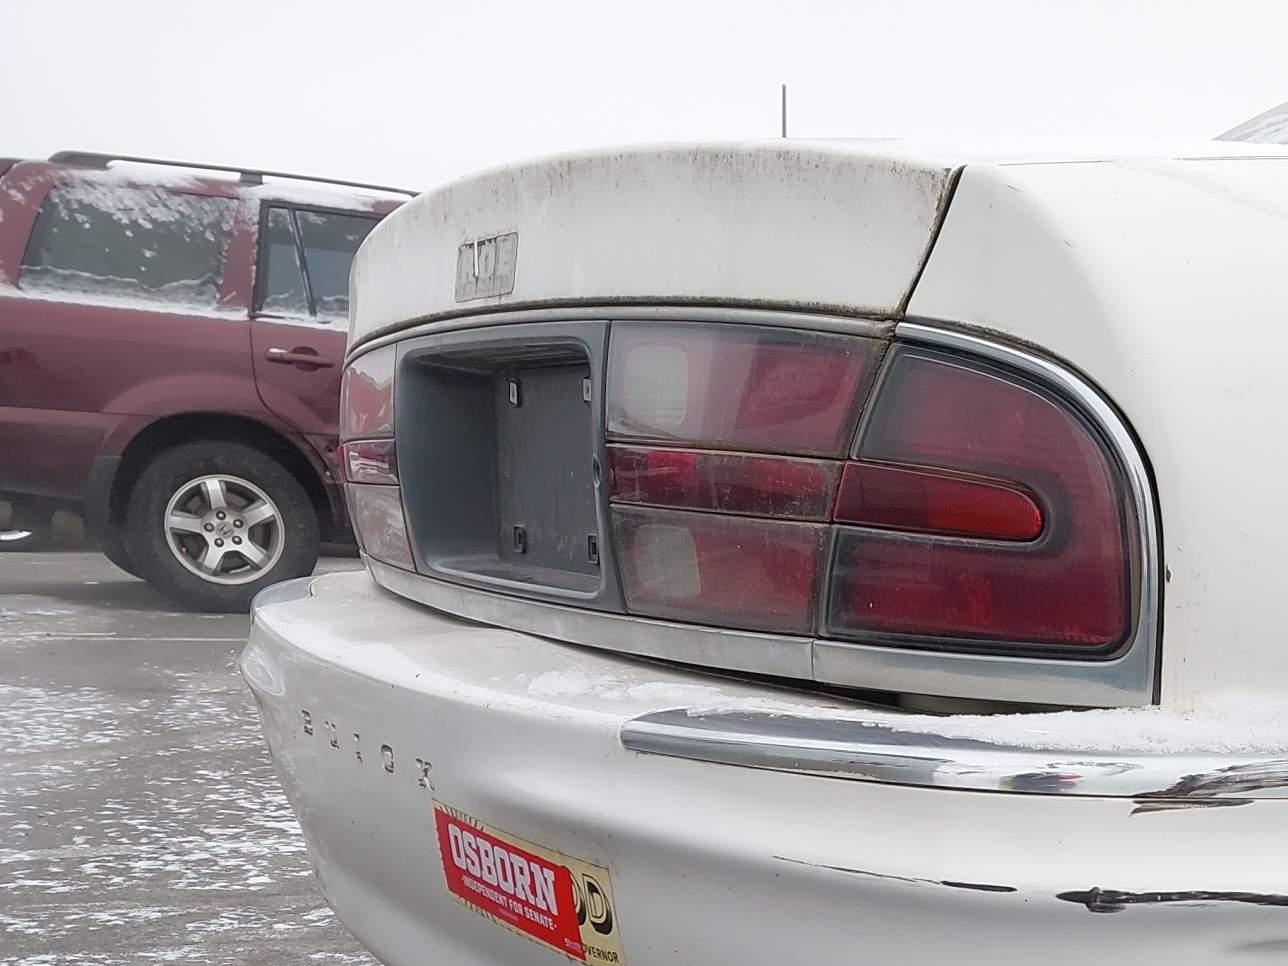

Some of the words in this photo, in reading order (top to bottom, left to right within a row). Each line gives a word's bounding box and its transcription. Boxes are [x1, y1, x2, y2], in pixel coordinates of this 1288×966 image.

[448, 823, 559, 916] OSBORN
[463, 876, 508, 908] INDEPENDENT
[508, 898, 524, 917] FOR
[524, 906, 555, 931] SENATE
[582, 942, 620, 964] OVERNOR
